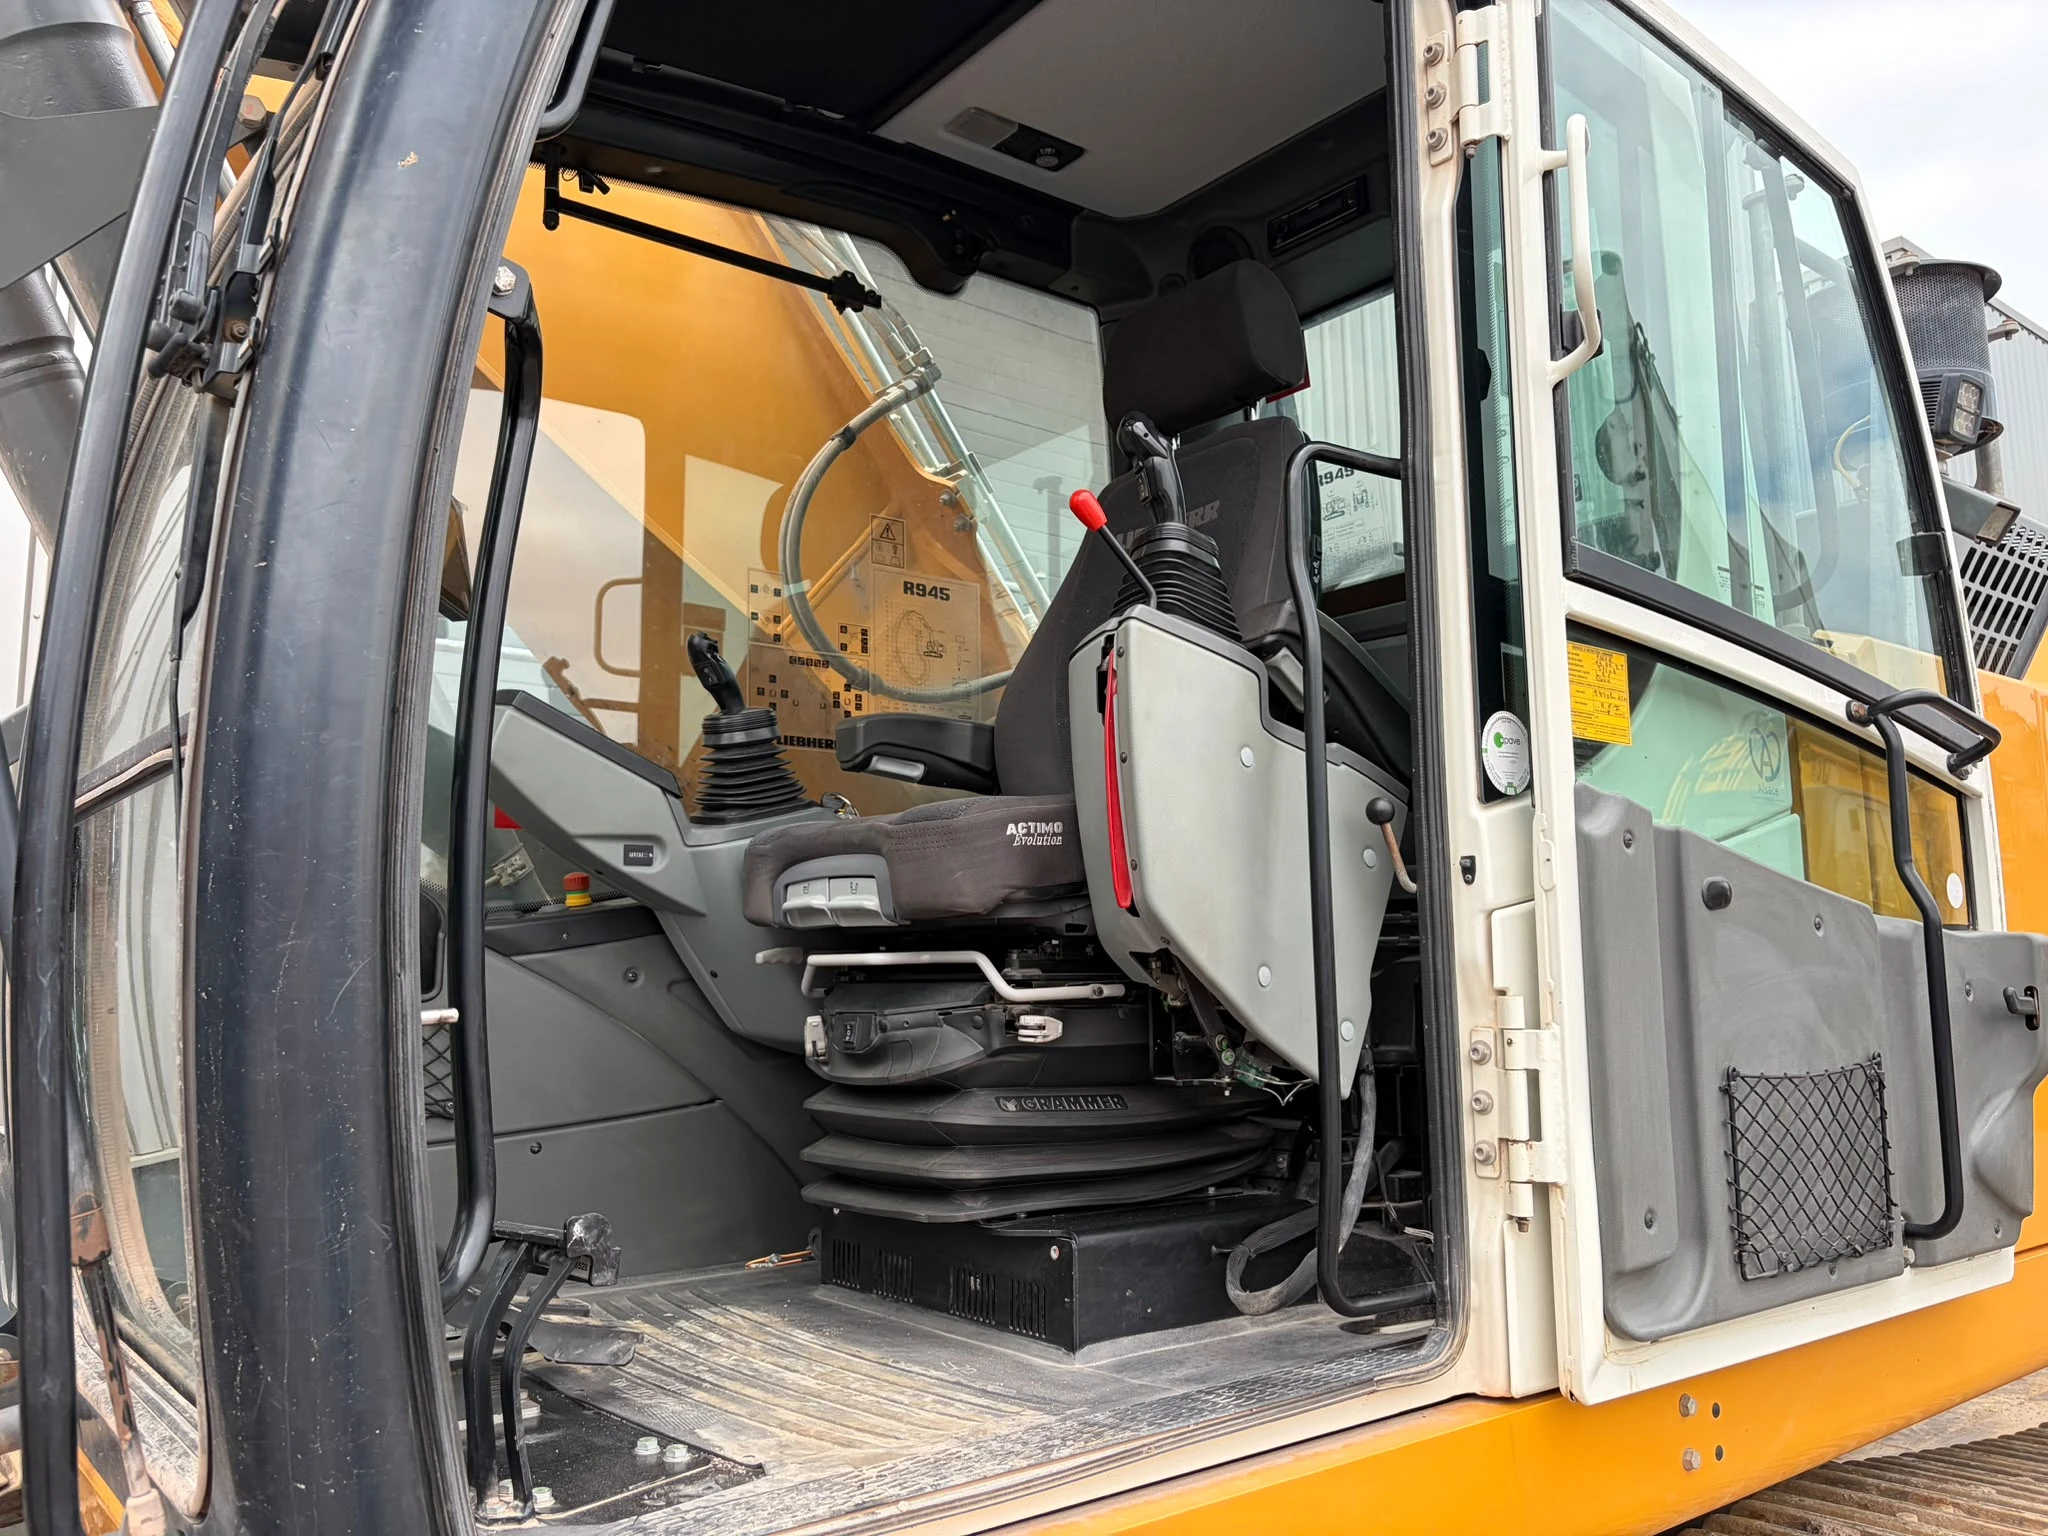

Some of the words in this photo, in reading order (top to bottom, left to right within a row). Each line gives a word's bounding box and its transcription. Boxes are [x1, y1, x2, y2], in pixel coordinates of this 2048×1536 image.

[903, 580, 951, 602] R945
[776, 735, 837, 750] LIEBHER
[1006, 821, 1064, 836] ACTIMO
[1012, 833, 1063, 847] Evolution
[1021, 1095, 1125, 1111] GRAMMER
